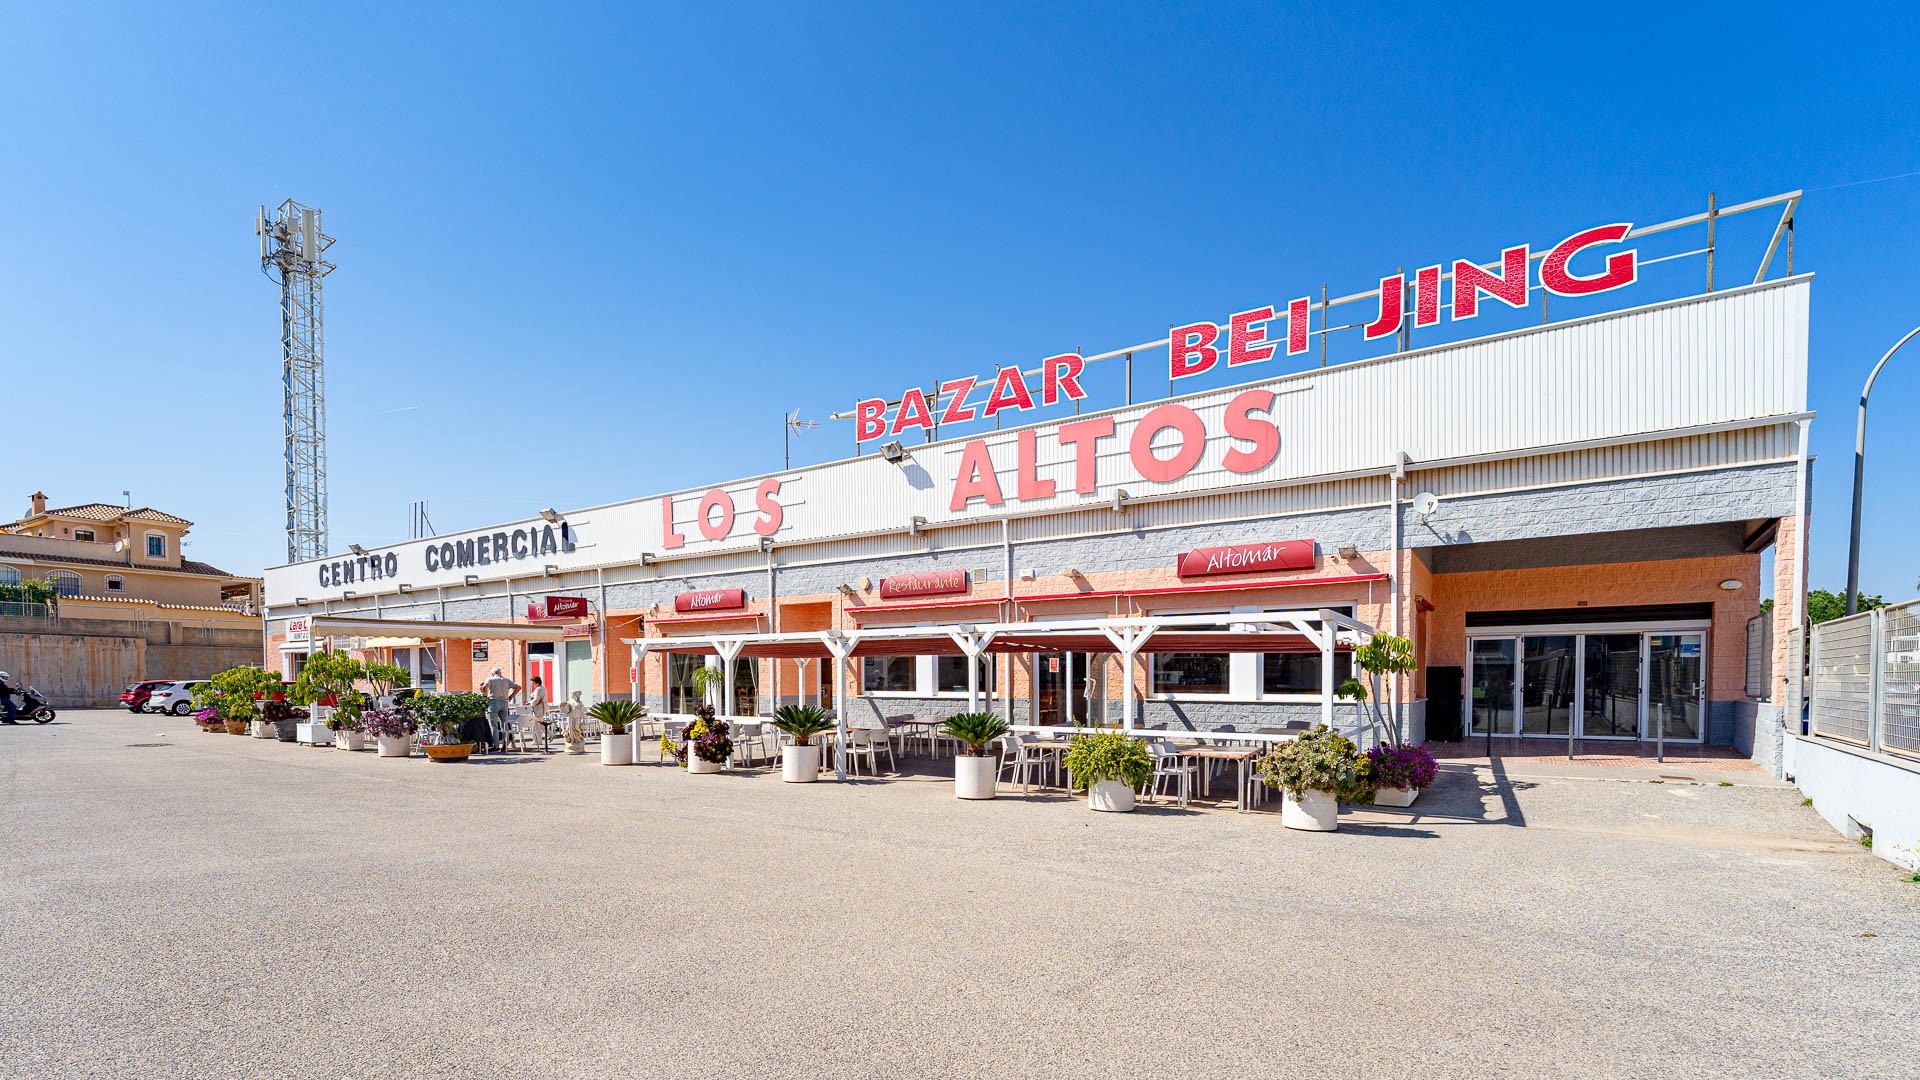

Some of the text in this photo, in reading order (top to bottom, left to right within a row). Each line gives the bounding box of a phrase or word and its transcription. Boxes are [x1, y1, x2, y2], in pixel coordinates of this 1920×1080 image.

[856, 222, 1638, 443] BAZAR BEI JING
[319, 390, 1280, 588] CENTRO COMERCIAL LOS ALTOS
[1207, 545, 1286, 573] Altomar
[889, 574, 959, 593] Restaurante
[690, 592, 725, 609] Altomar
